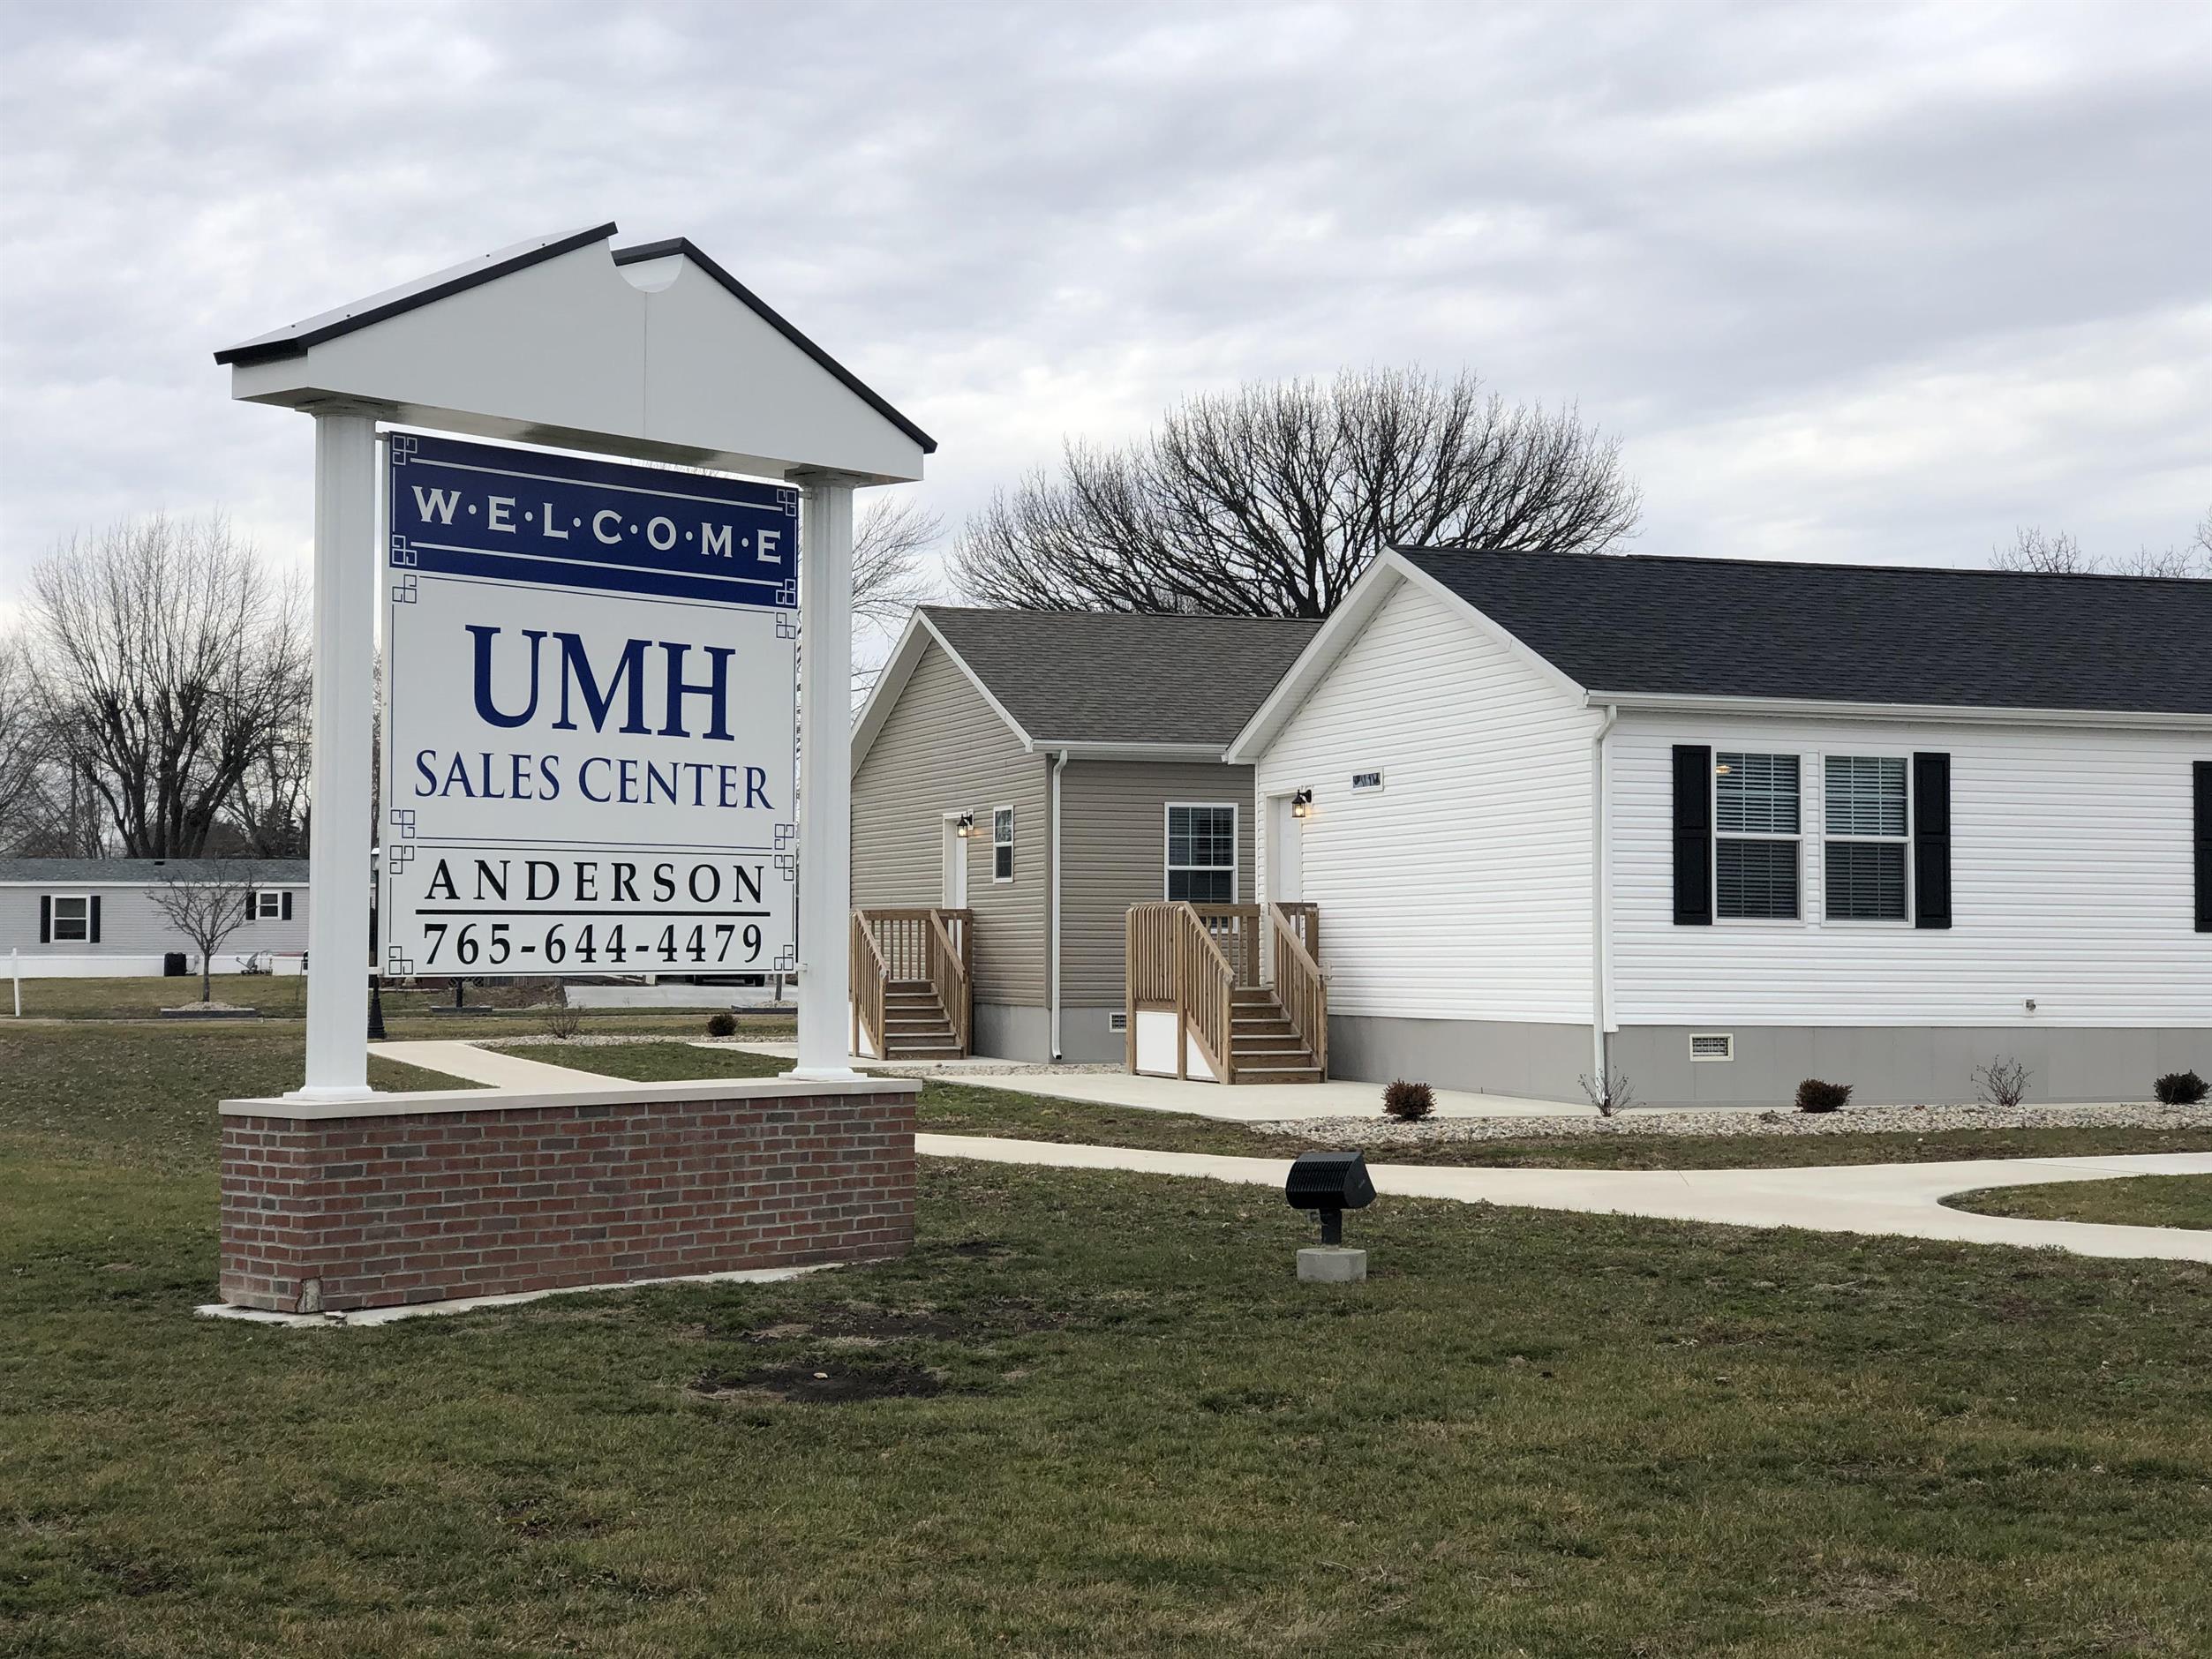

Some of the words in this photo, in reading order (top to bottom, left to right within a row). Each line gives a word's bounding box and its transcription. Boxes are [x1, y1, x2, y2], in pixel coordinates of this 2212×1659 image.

[465, 625, 735, 741] UMH
[415, 749, 560, 801] SALES
[578, 756, 775, 810] CENTER
[424, 858, 764, 904] ANDERSON
[424, 923, 763, 965] 765-644-4479
